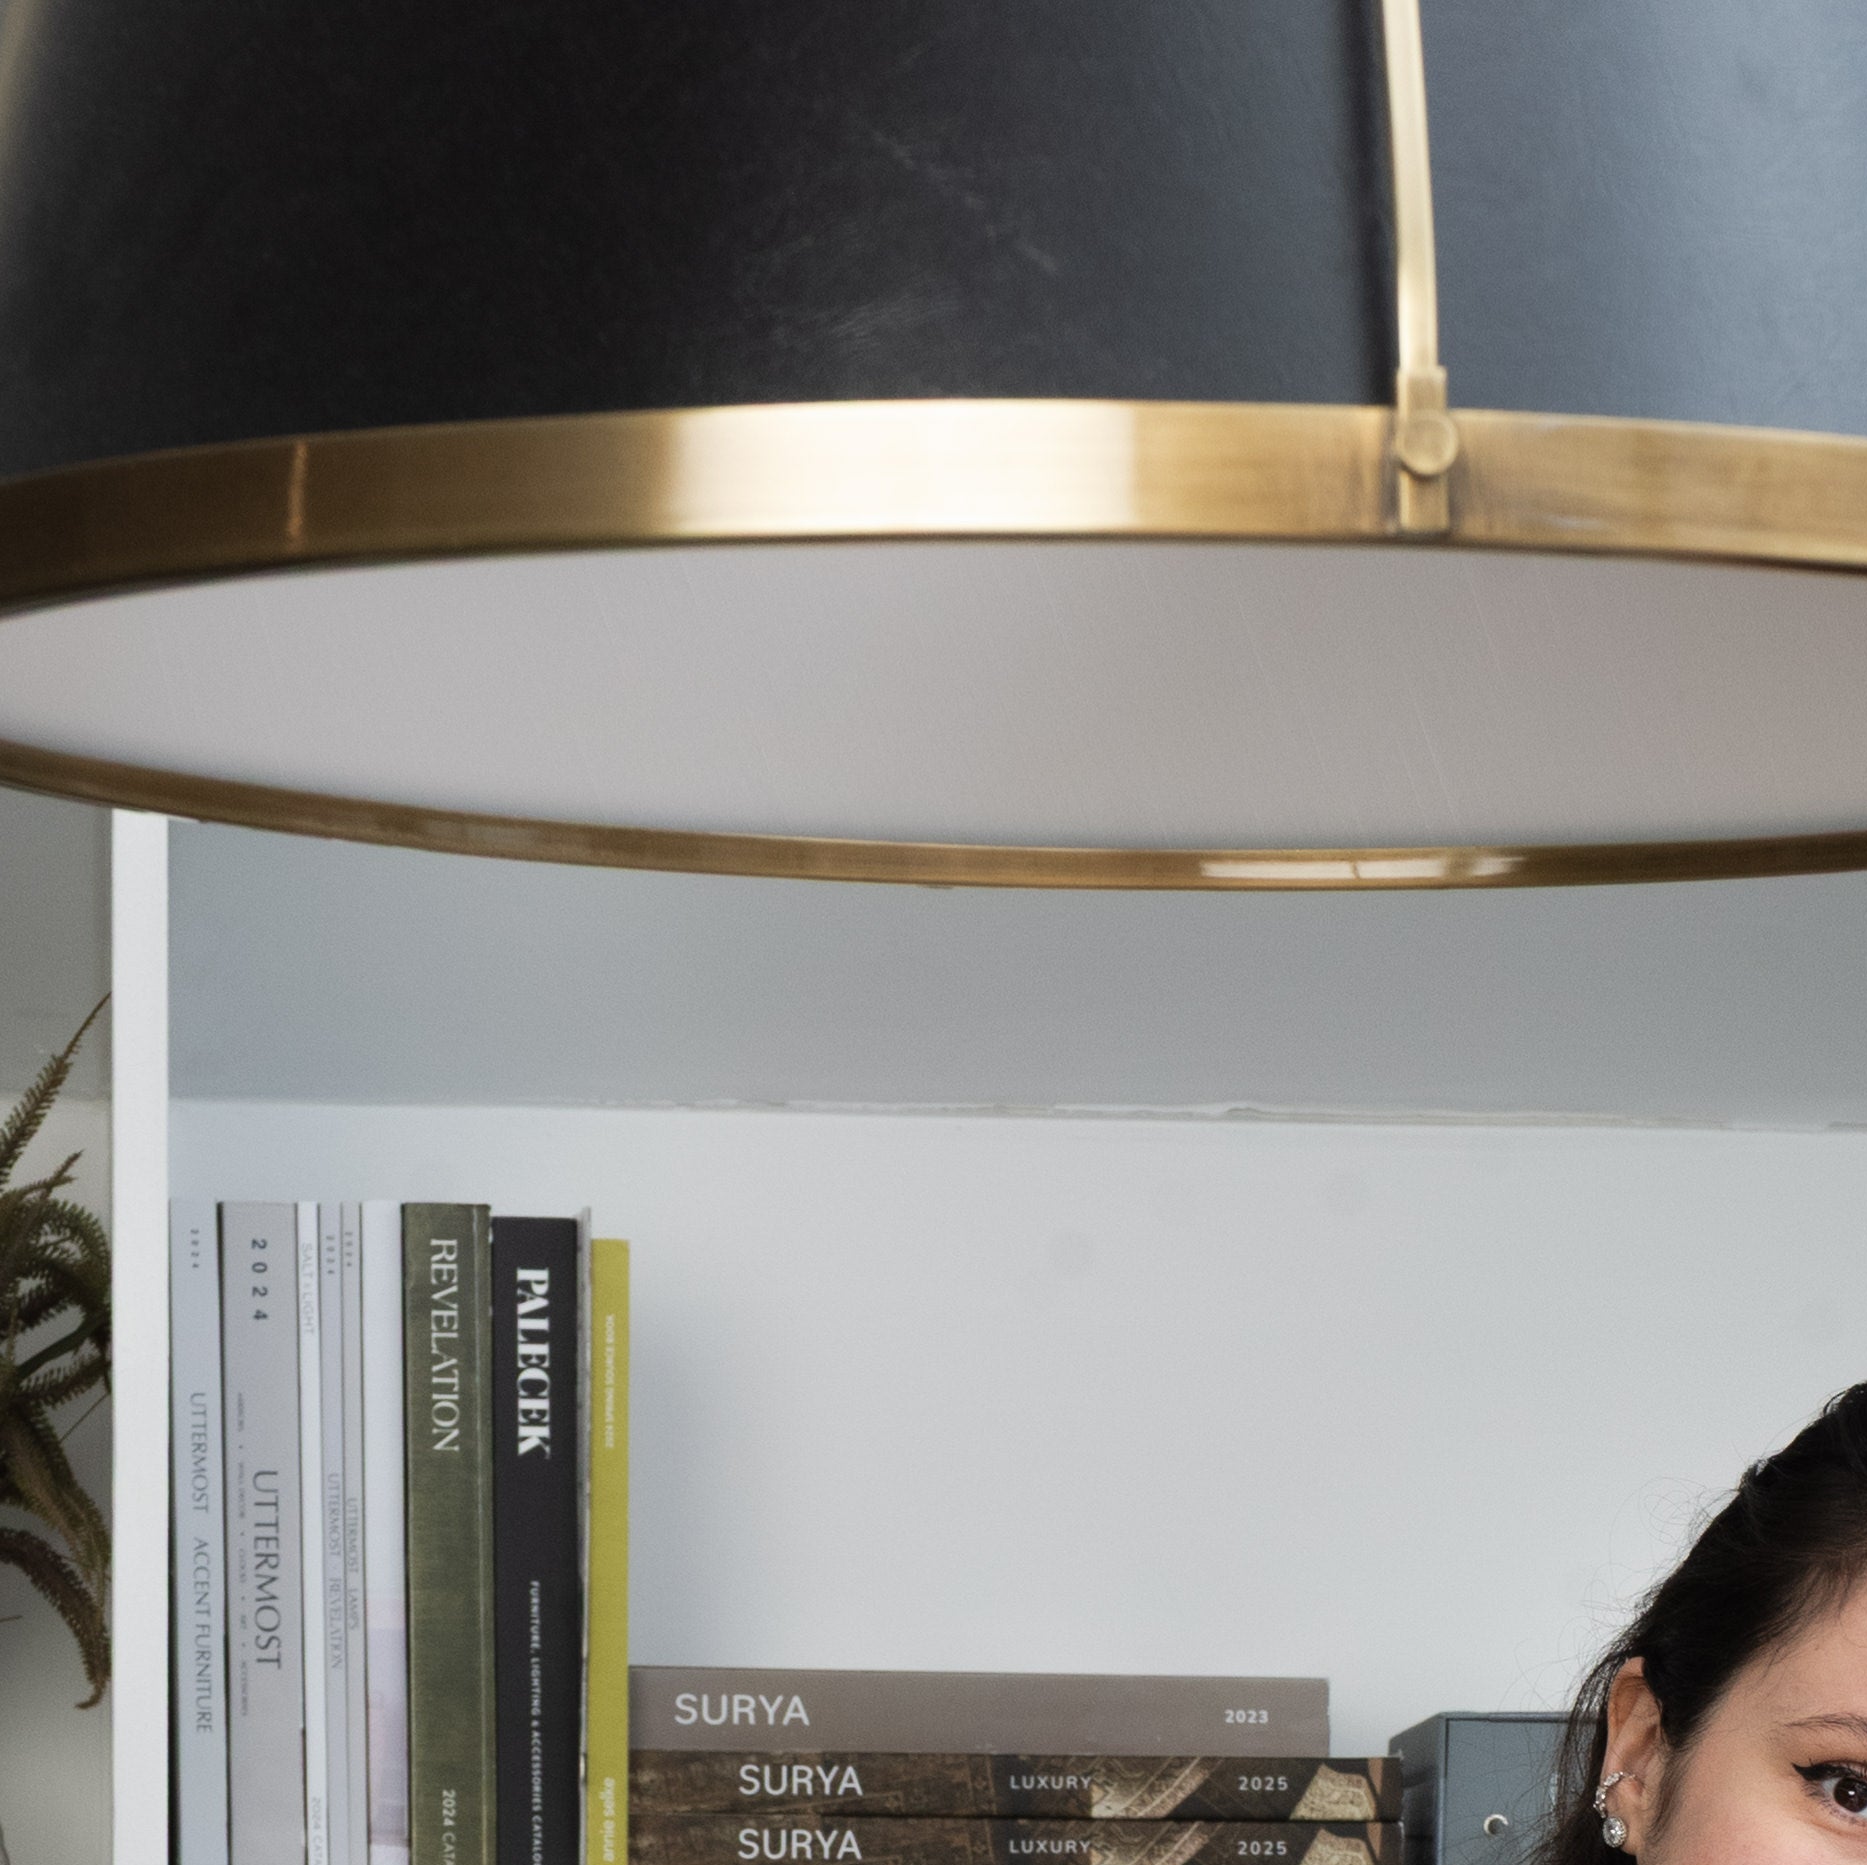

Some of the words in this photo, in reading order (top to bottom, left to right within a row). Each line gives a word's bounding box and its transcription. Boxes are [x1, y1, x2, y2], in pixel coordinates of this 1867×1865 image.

[250, 1238, 269, 1321] 2024
[303, 1292, 315, 1335] LIGHT
[429, 1238, 460, 1452] REVELATION
[516, 1268, 551, 1455] PALECEK
[189, 1391, 210, 1514] UTTERMOST
[327, 1473, 342, 1557] UTTERMOST
[346, 1497, 359, 1574] UTTERMOST
[193, 1537, 212, 1617] ACCENT
[252, 1470, 282, 1670] UTTERMOST
[347, 1588, 359, 1631] LAMPS
[329, 1577, 343, 1670] REVELATION
[194, 1623, 213, 1732] FURNITURE
[530, 1656, 542, 1717] LIGHTING
[674, 1692, 810, 1726] SURYA
[1224, 1709, 1269, 1725] 2023
[441, 1789, 457, 1827] 2024
[530, 1730, 543, 1813] ACCESSORIES
[738, 1763, 864, 1797] SURYA
[1009, 1774, 1092, 1792] LUXURY
[1238, 1775, 1289, 1792] 2025
[599, 1819, 616, 1863] annie
[737, 1827, 863, 1861] SURYA
[1008, 1838, 1092, 1856] LUXURY
[1237, 1840, 1288, 1856] 2025
